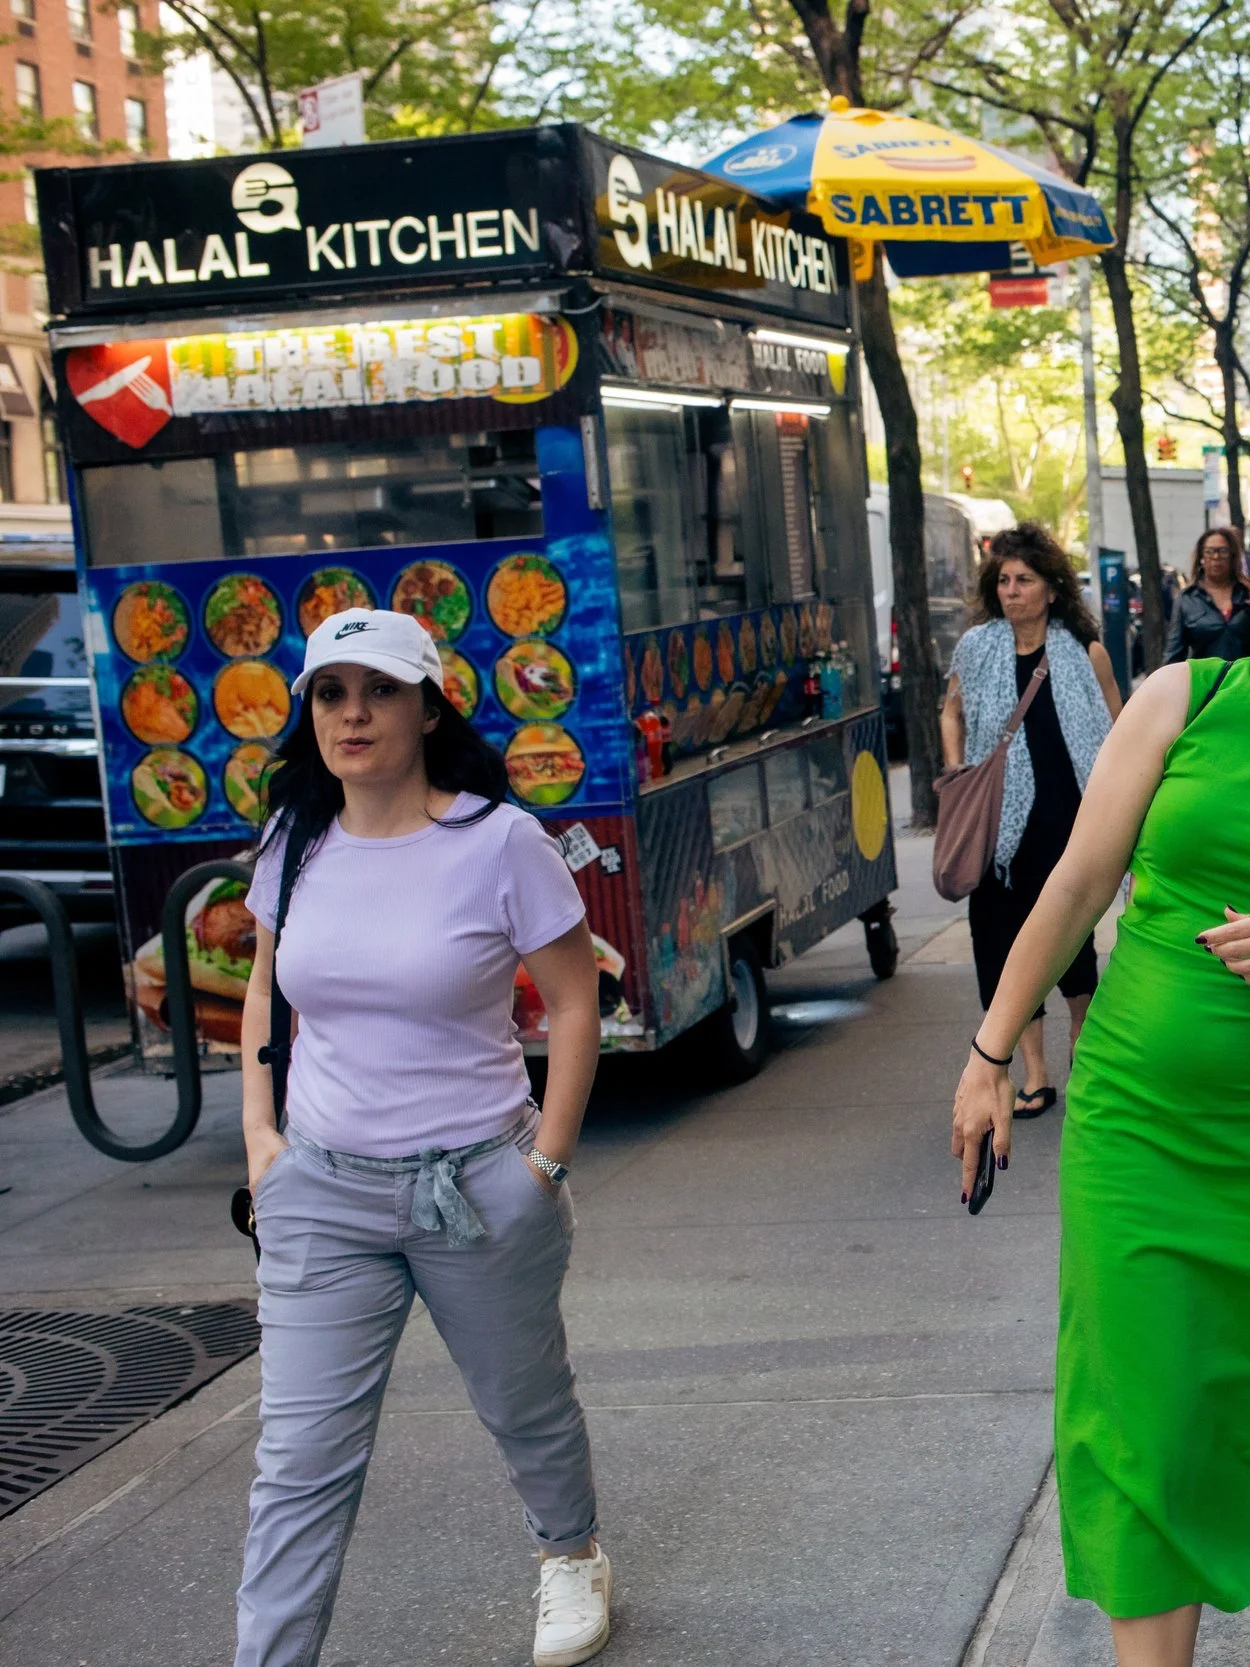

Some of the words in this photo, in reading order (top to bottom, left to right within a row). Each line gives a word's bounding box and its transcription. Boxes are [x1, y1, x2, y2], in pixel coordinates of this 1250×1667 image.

[833, 139, 953, 159] SABRETT
[830, 193, 1029, 226] SABRETT
[87, 231, 271, 289] HALAL
[305, 207, 541, 272] KITCHEN
[655, 187, 748, 274] HALAL
[751, 218, 840, 296] KITCHEN
[226, 333, 340, 373] THE
[352, 321, 503, 363] BEST
[752, 342, 792, 373] HALAL
[794, 347, 827, 376] FOOD
[341, 622, 369, 632] NIKE
[822, 869, 850, 904] FOOD
